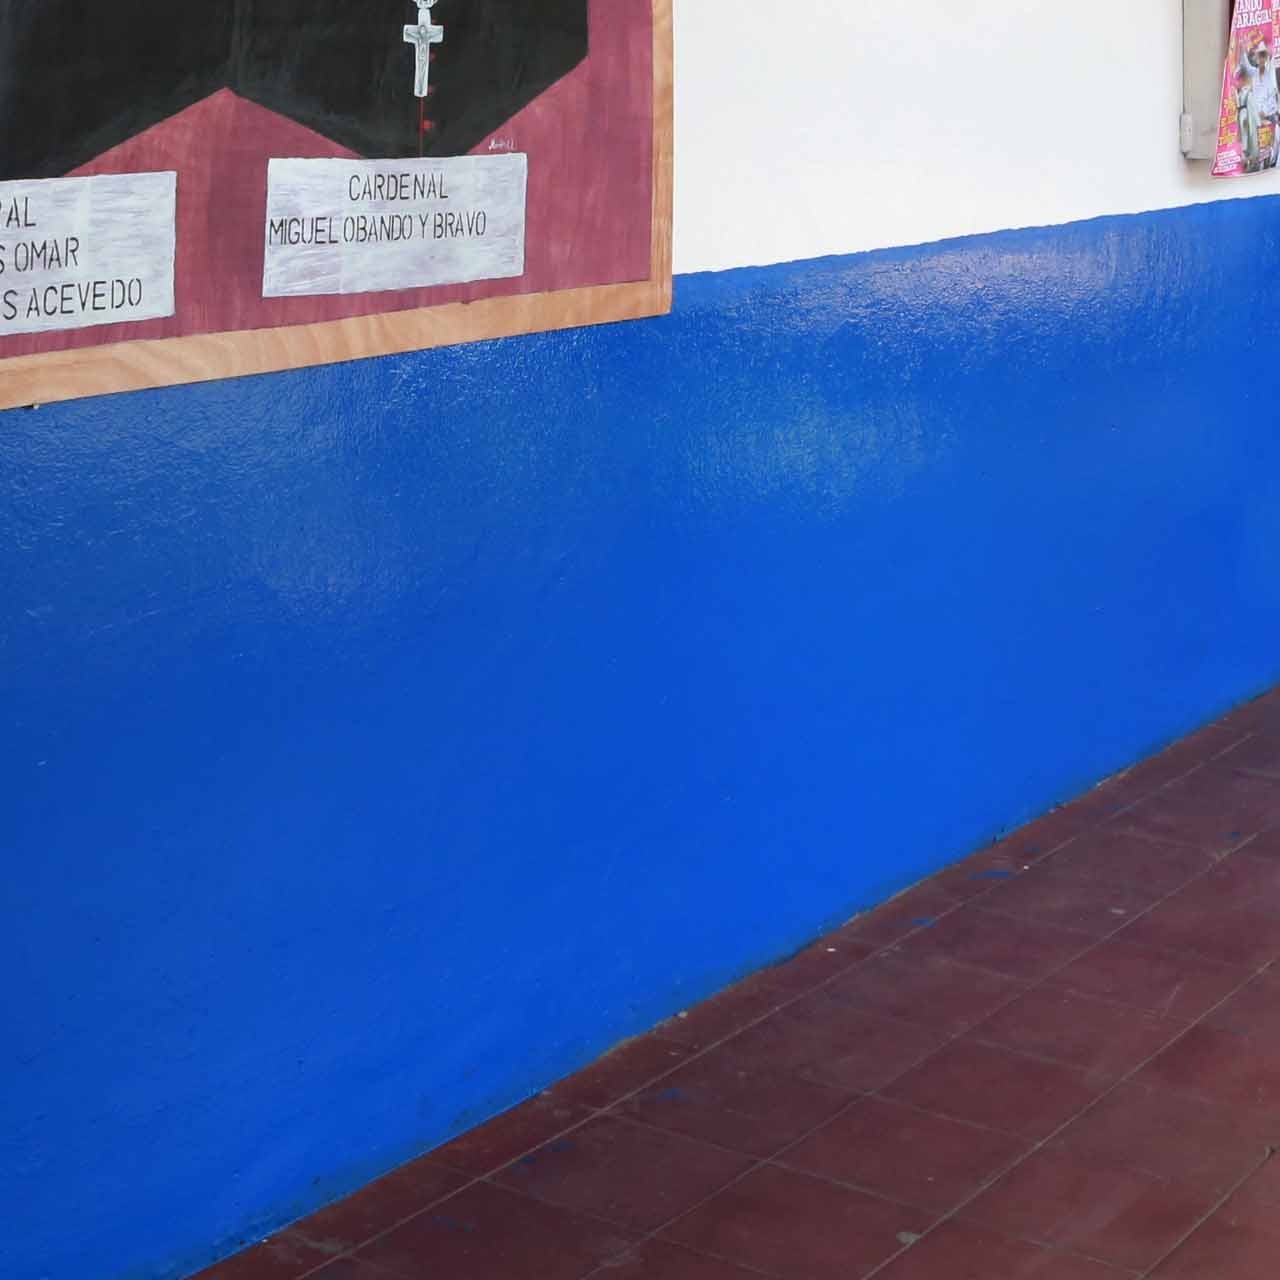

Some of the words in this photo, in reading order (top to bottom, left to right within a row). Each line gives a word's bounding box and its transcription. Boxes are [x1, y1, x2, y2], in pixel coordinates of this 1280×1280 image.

[348, 173, 449, 202] CARDENAL
[269, 216, 339, 246] MIGUEL
[343, 214, 413, 243] OBANDO
[419, 212, 429, 240] Y
[432, 211, 487, 239] BRAVO
[14, 237, 80, 273] OMAR
[26, 277, 144, 318] ACEVEDO
